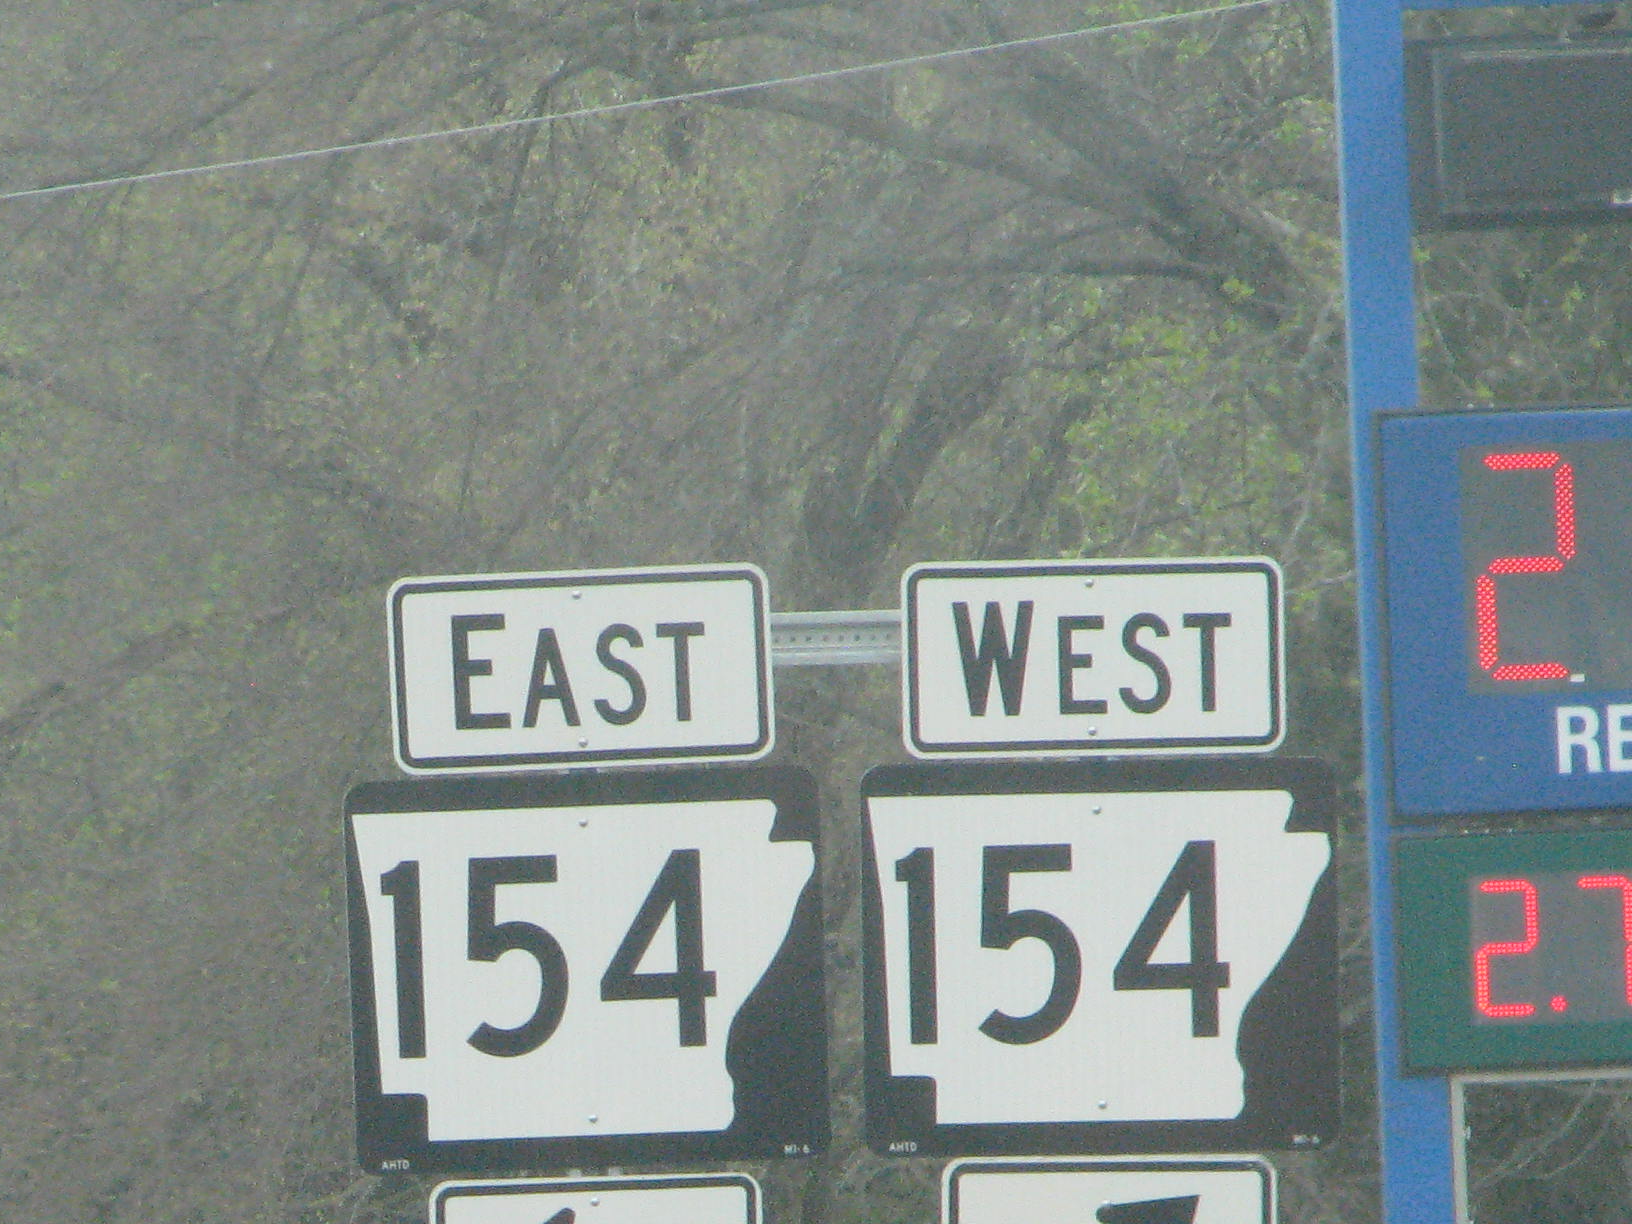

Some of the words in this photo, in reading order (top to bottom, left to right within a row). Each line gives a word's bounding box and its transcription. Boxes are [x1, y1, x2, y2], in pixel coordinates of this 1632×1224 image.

[450, 612, 706, 732] EAST
[951, 600, 1232, 718] WEST
[379, 848, 718, 1060] 154
[894, 840, 1231, 1046] 154
[381, 1159, 411, 1170] AHTD
